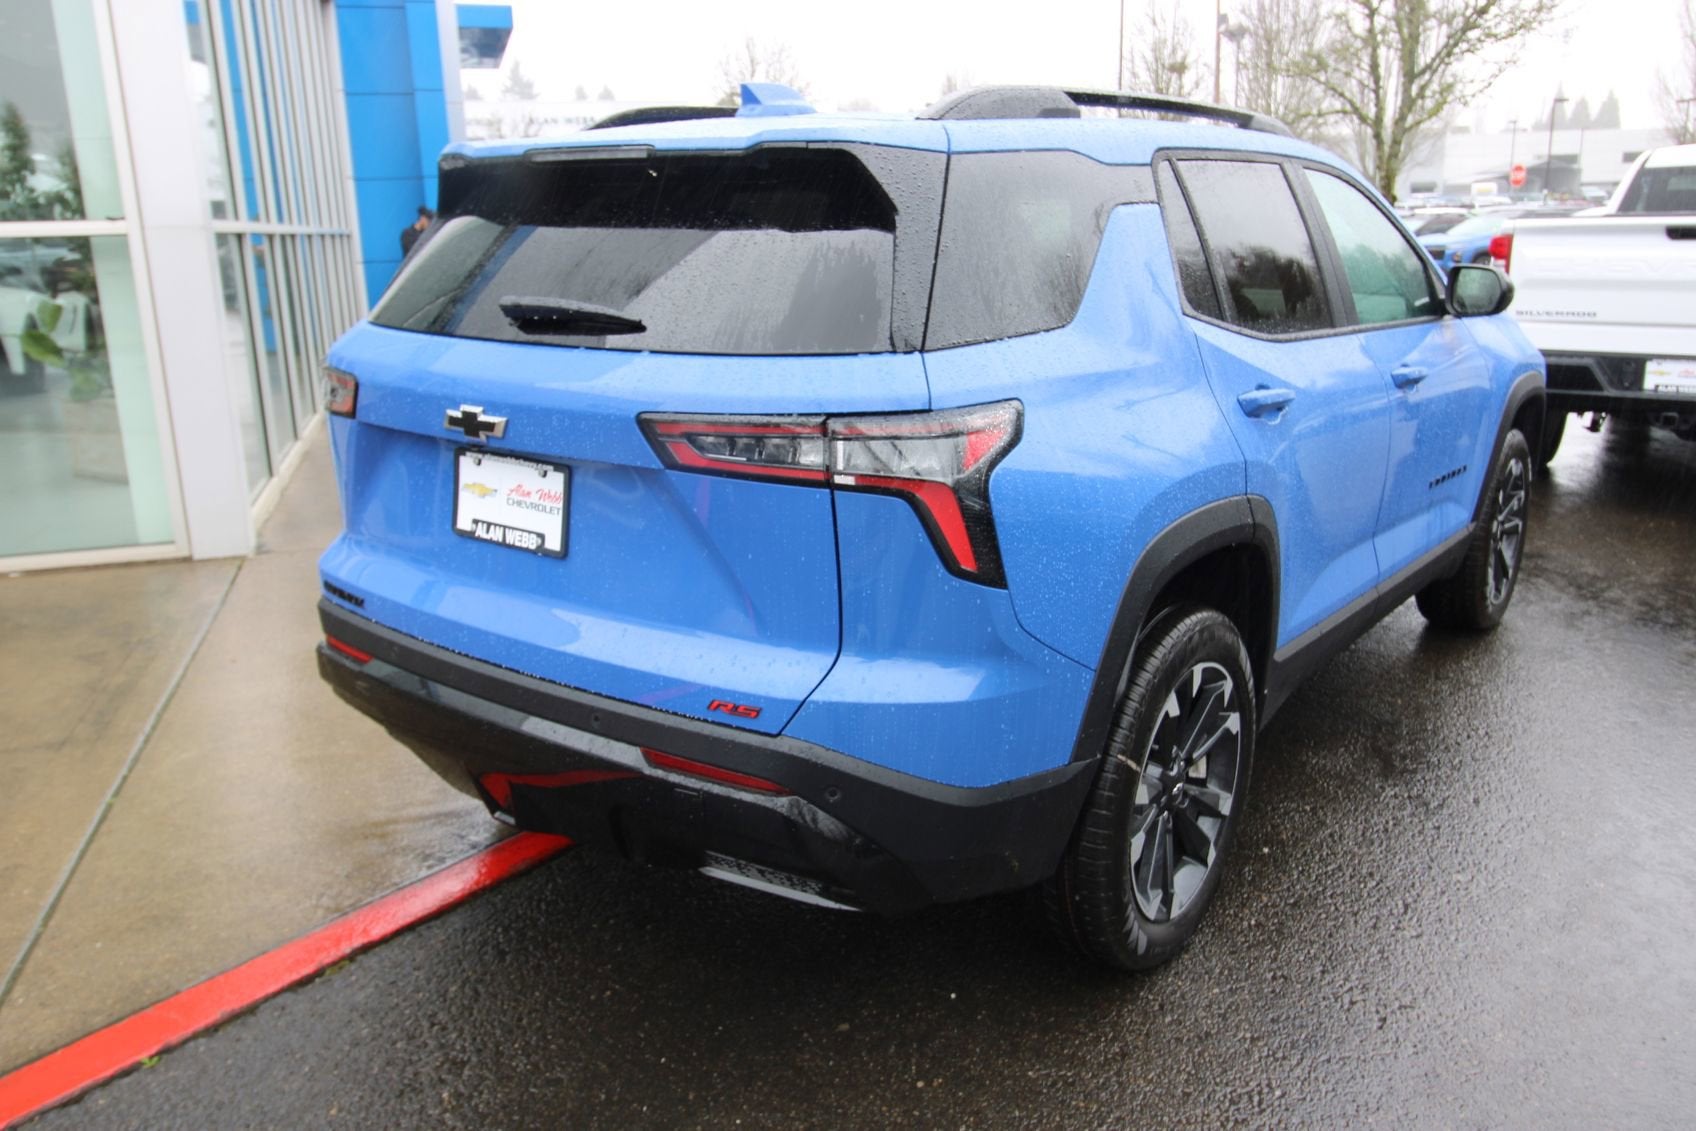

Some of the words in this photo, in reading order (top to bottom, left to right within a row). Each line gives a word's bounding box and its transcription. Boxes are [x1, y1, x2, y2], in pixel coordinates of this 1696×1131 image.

[506, 483, 532, 498] Alan
[535, 487, 563, 505] Webb
[506, 497, 562, 516] CHEVROLET
[474, 521, 504, 542] ALAN
[504, 527, 538, 549] WEBB
[707, 699, 762, 719] RS
